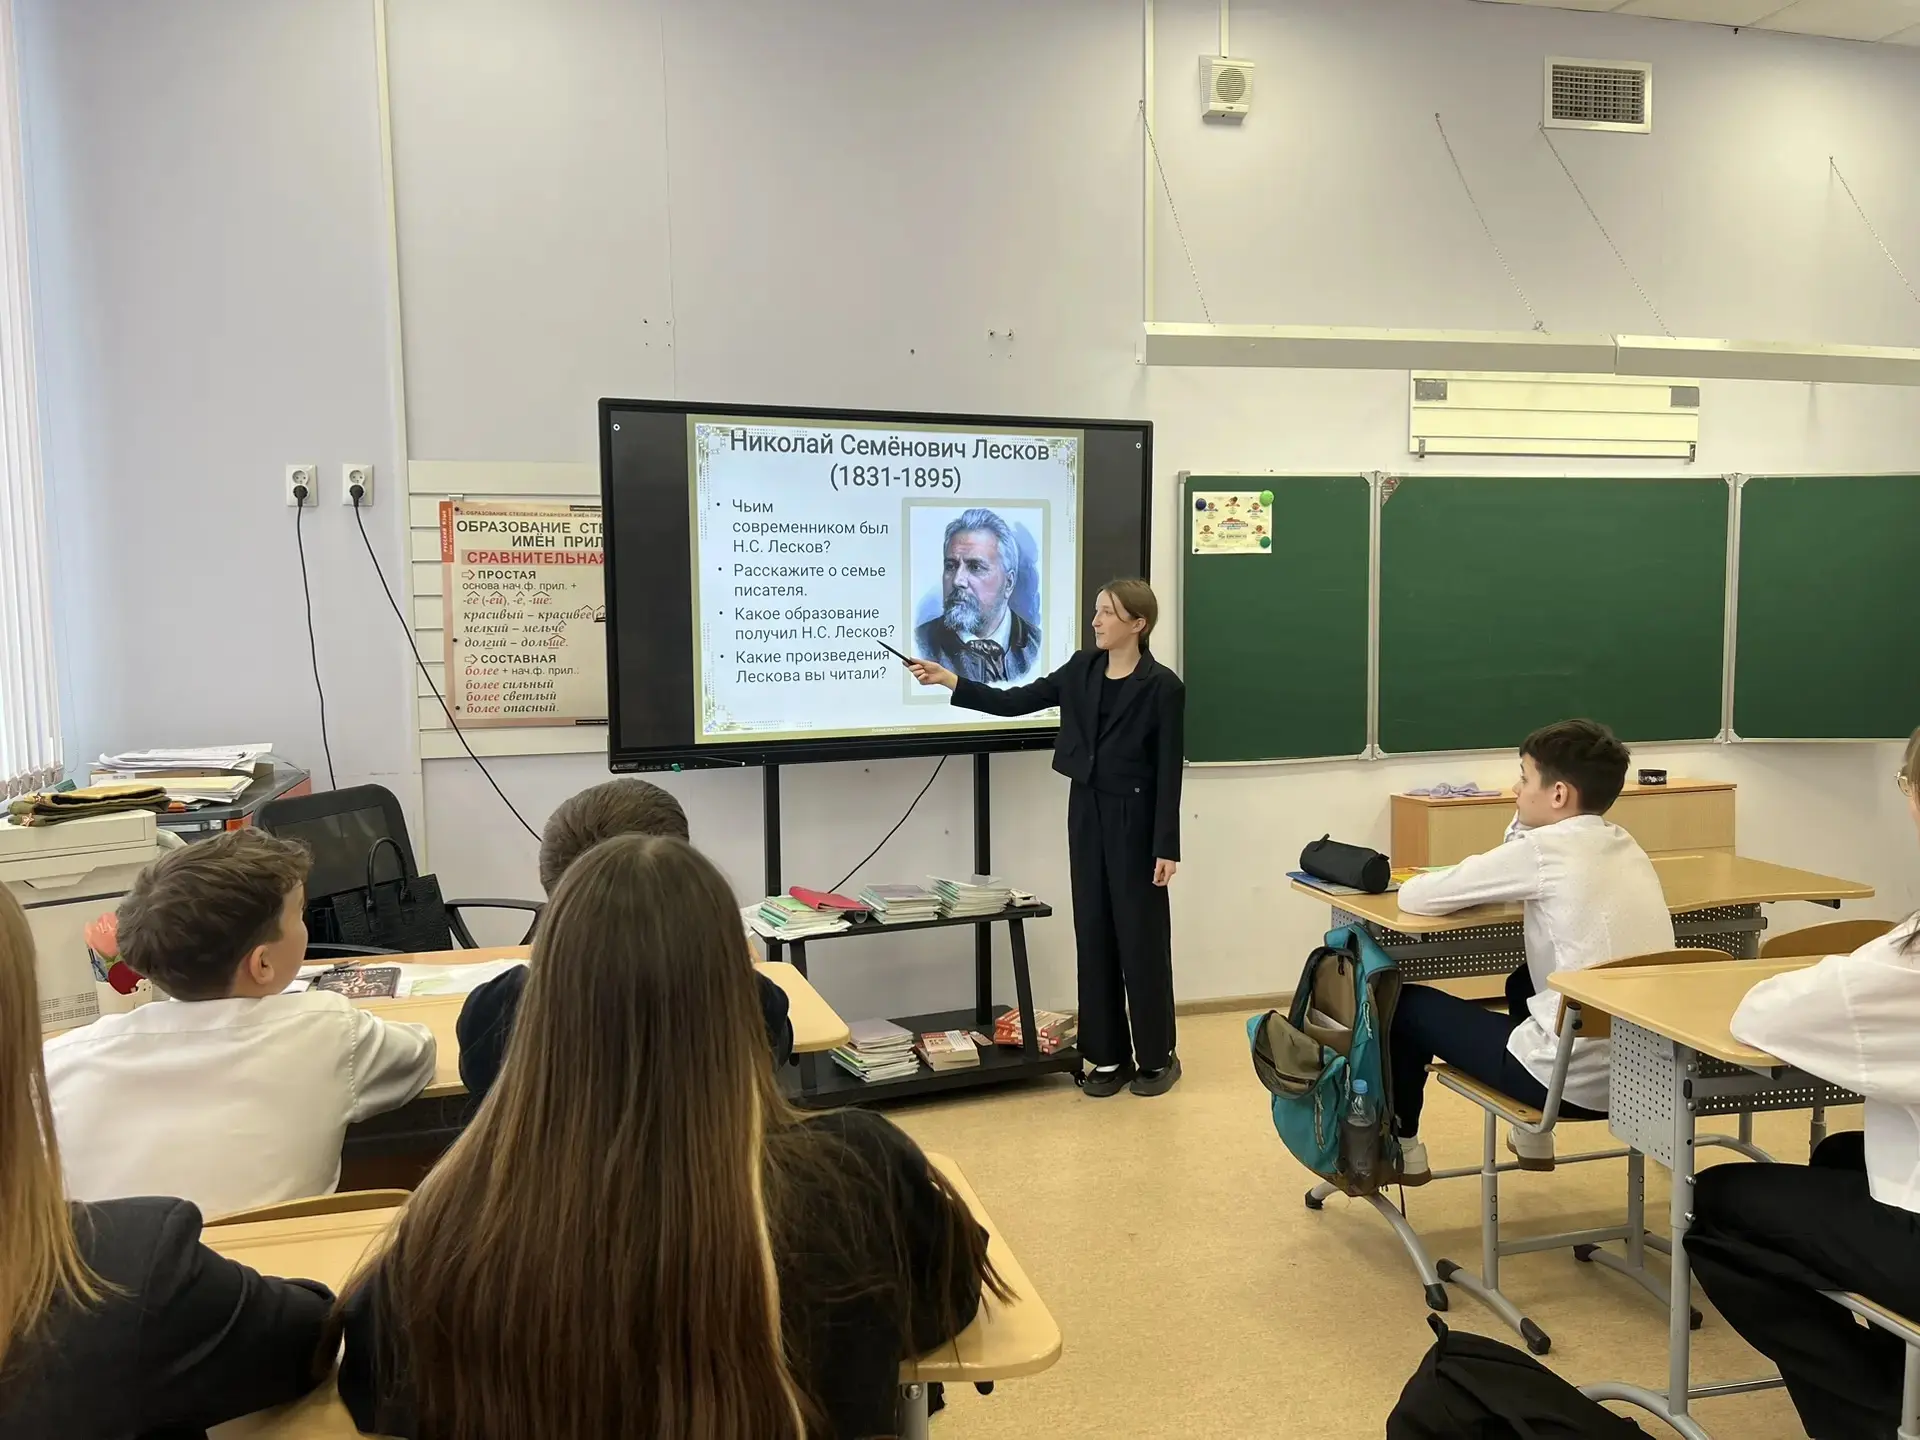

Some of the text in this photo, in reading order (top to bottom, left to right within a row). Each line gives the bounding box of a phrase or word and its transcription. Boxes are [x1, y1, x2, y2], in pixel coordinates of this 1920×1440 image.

[730, 429, 1050, 461] Николай Семёнович Лесков
[830, 463, 962, 494] (1831-1895)
[732, 499, 774, 513] Чьим
[456, 520, 571, 534] ОБРАЗОВАНИЕ
[732, 520, 889, 536] современником был
[512, 533, 555, 547] ИМЁН
[733, 539, 831, 553] Н.С. Лесков?
[478, 570, 537, 579] ПРОСТАЯ
[734, 563, 886, 577] Расскажите о семье
[734, 586, 808, 596] писателя.
[463, 610, 523, 621] красивый
[735, 607, 880, 622] Какое образование
[463, 623, 508, 633] мелкий
[522, 624, 565, 633] мельче
[735, 625, 895, 642] получил Н.С. Лесков?
[464, 637, 506, 647] долгий
[521, 638, 568, 647] дольше.
[480, 655, 556, 663] СОСТАВНАЯ
[736, 650, 890, 665] Какие произведения
[465, 665, 499, 676] более
[736, 667, 887, 683] Лескова вы читали?
[465, 679, 554, 690] более сильный
[466, 691, 557, 702] более светлый
[466, 703, 500, 714] более
